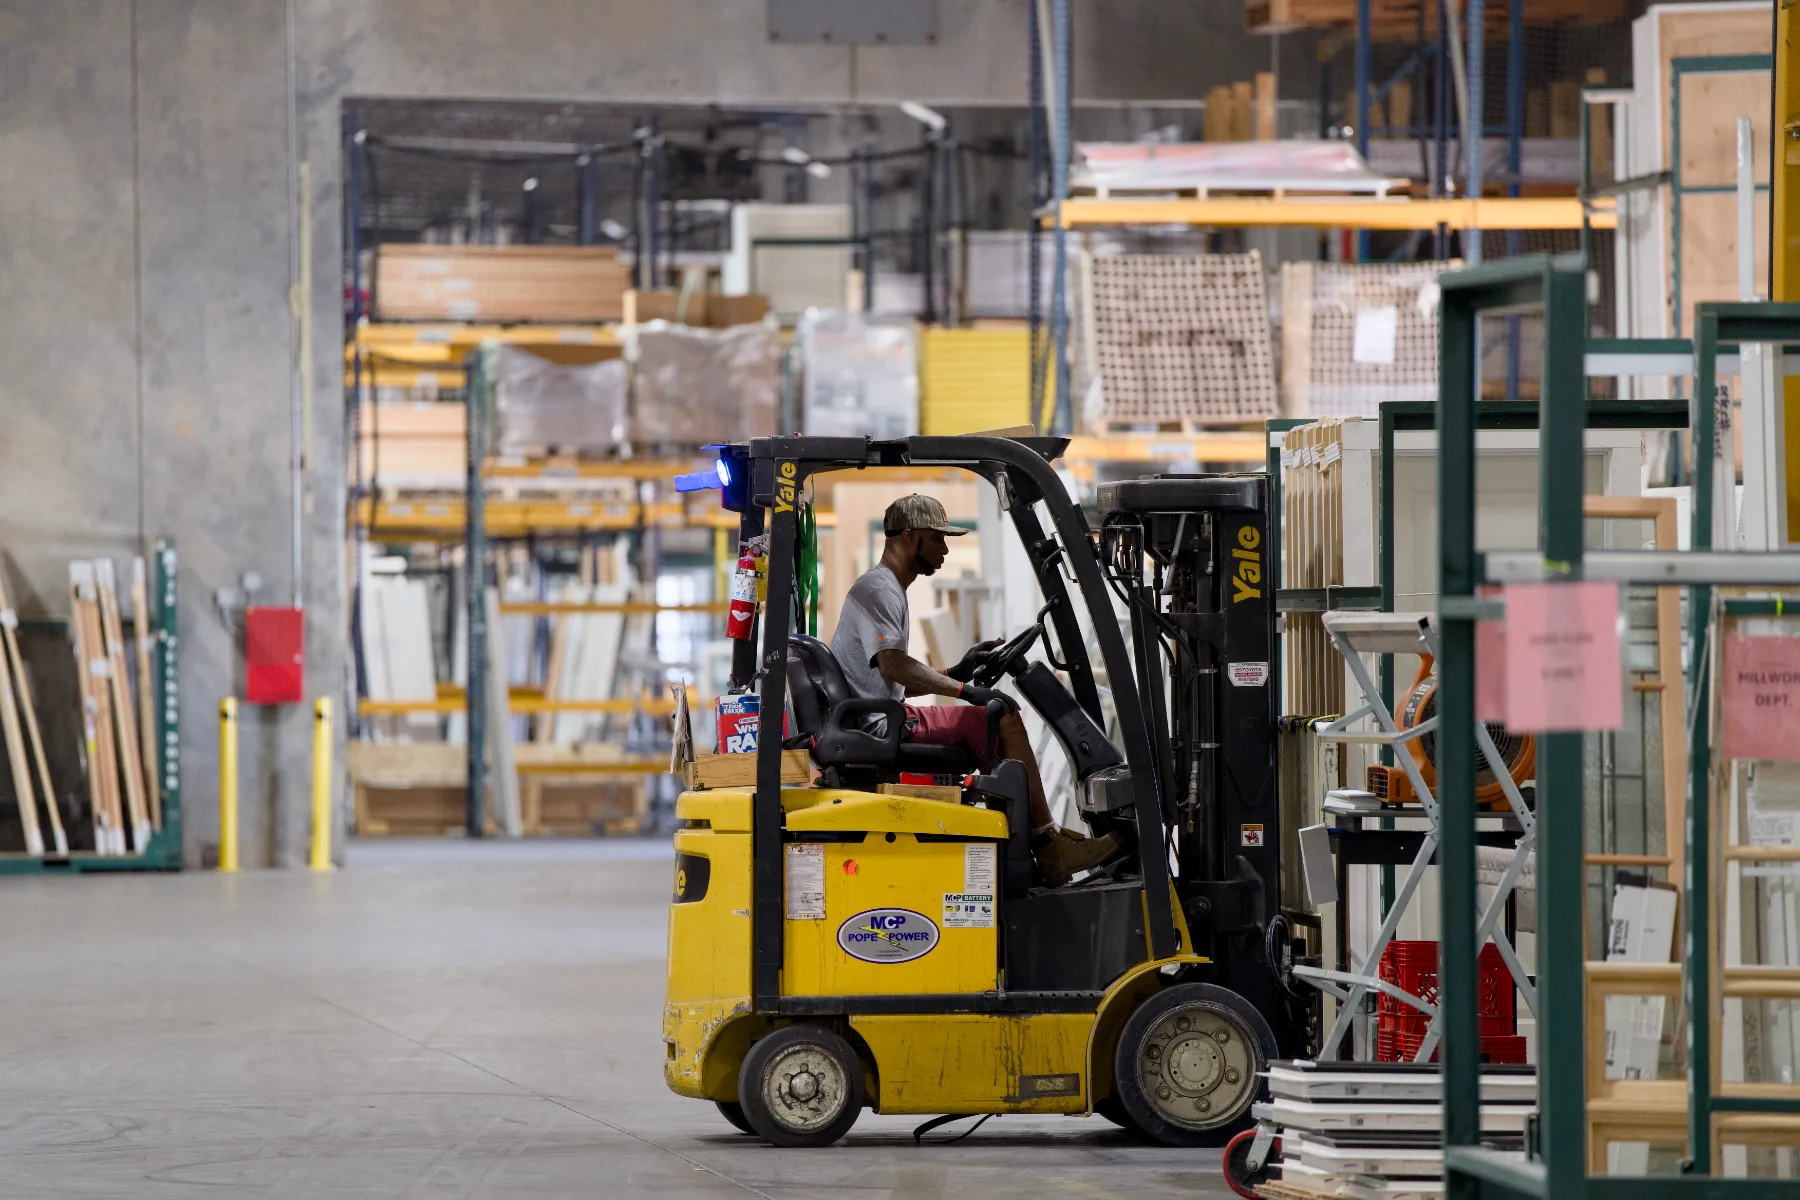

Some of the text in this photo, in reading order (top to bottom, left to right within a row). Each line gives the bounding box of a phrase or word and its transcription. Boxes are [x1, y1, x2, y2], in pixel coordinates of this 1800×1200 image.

[775, 462, 797, 513] Yale
[1231, 525, 1261, 604] Yale
[726, 732, 758, 754] RA
[870, 915, 906, 929] MCP
[848, 932, 930, 943] POPE POWER
